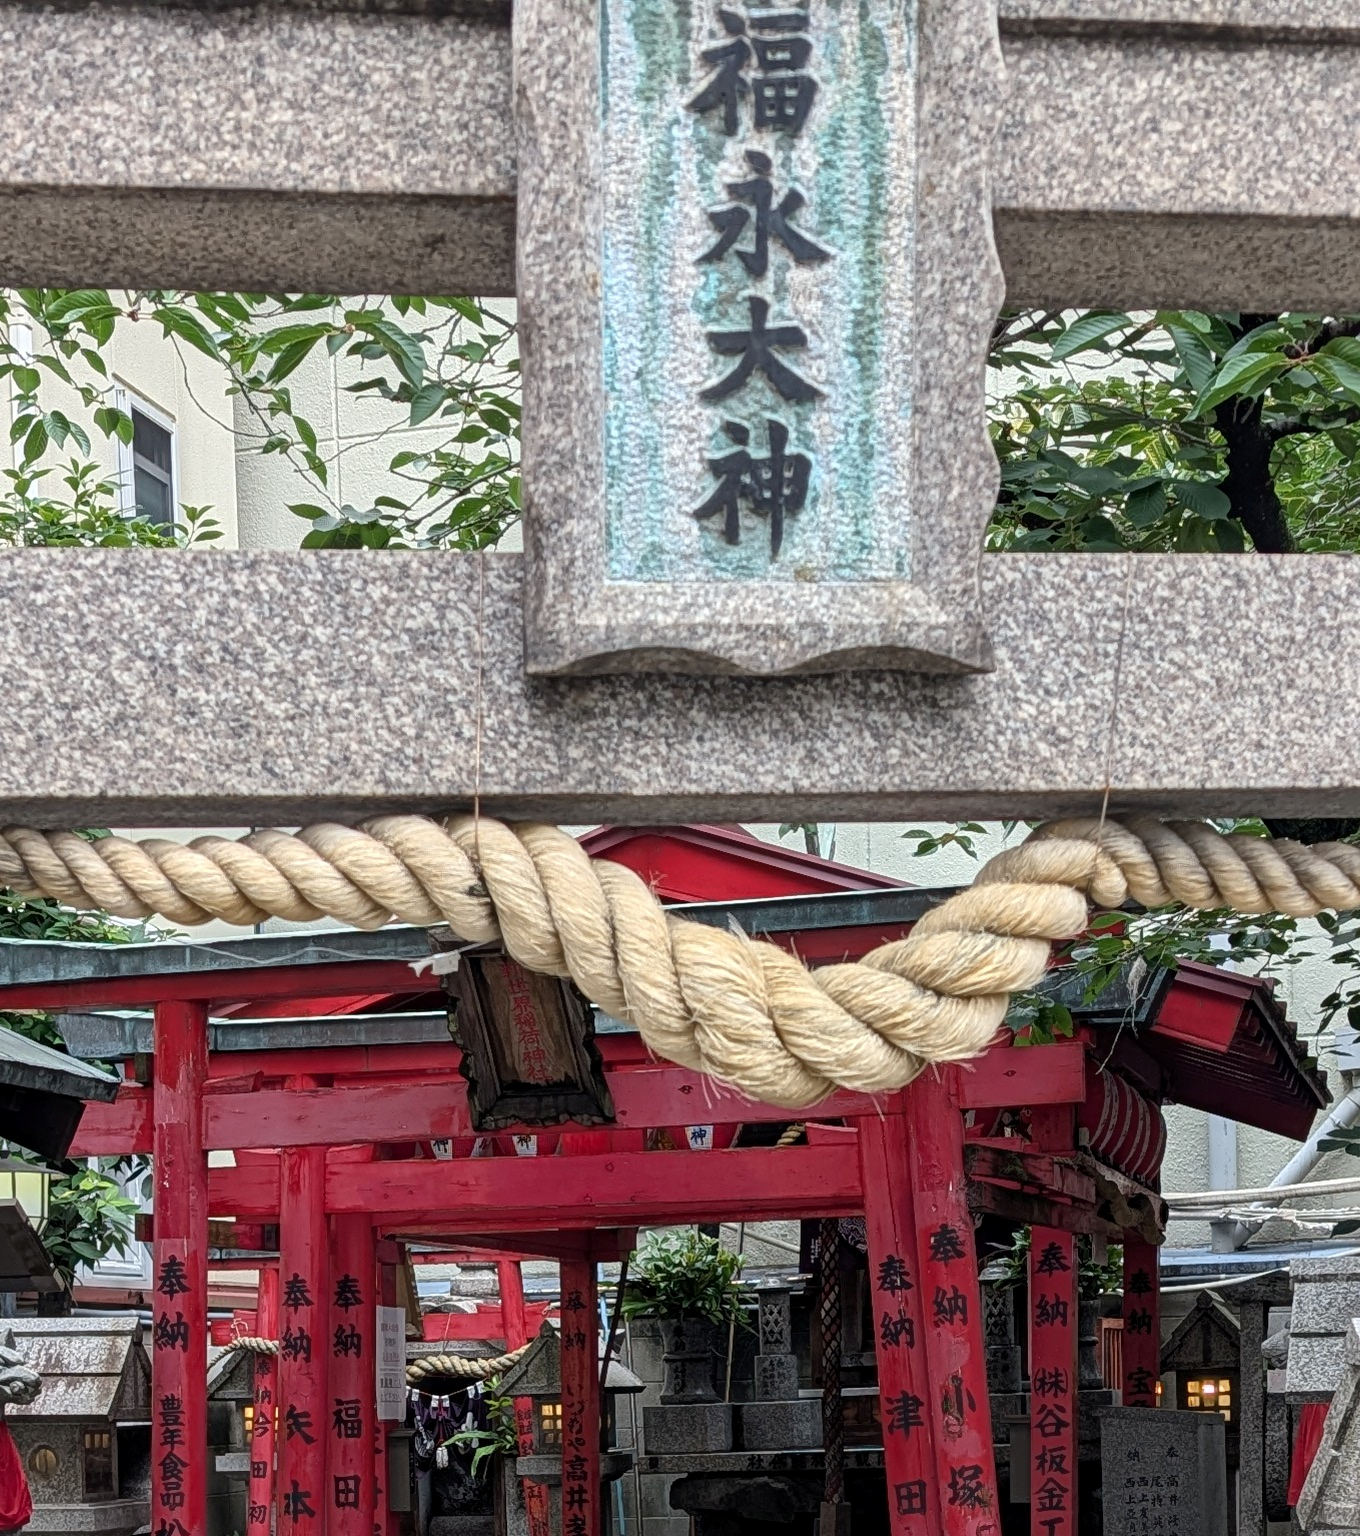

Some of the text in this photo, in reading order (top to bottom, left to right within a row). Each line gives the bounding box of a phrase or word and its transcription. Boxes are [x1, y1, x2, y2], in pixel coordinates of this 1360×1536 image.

[684, 8, 835, 562] 福永大神
[154, 1254, 192, 1354] 奉納
[281, 1272, 315, 1365] 奉納
[332, 1272, 364, 1360] 奉納
[878, 1254, 915, 1350] 奉納
[929, 1221, 968, 1327] 奉納
[1035, 1241, 1071, 1328] 奉納
[1127, 1268, 1153, 1336] 奉納
[253, 1358, 273, 1406] 奉納
